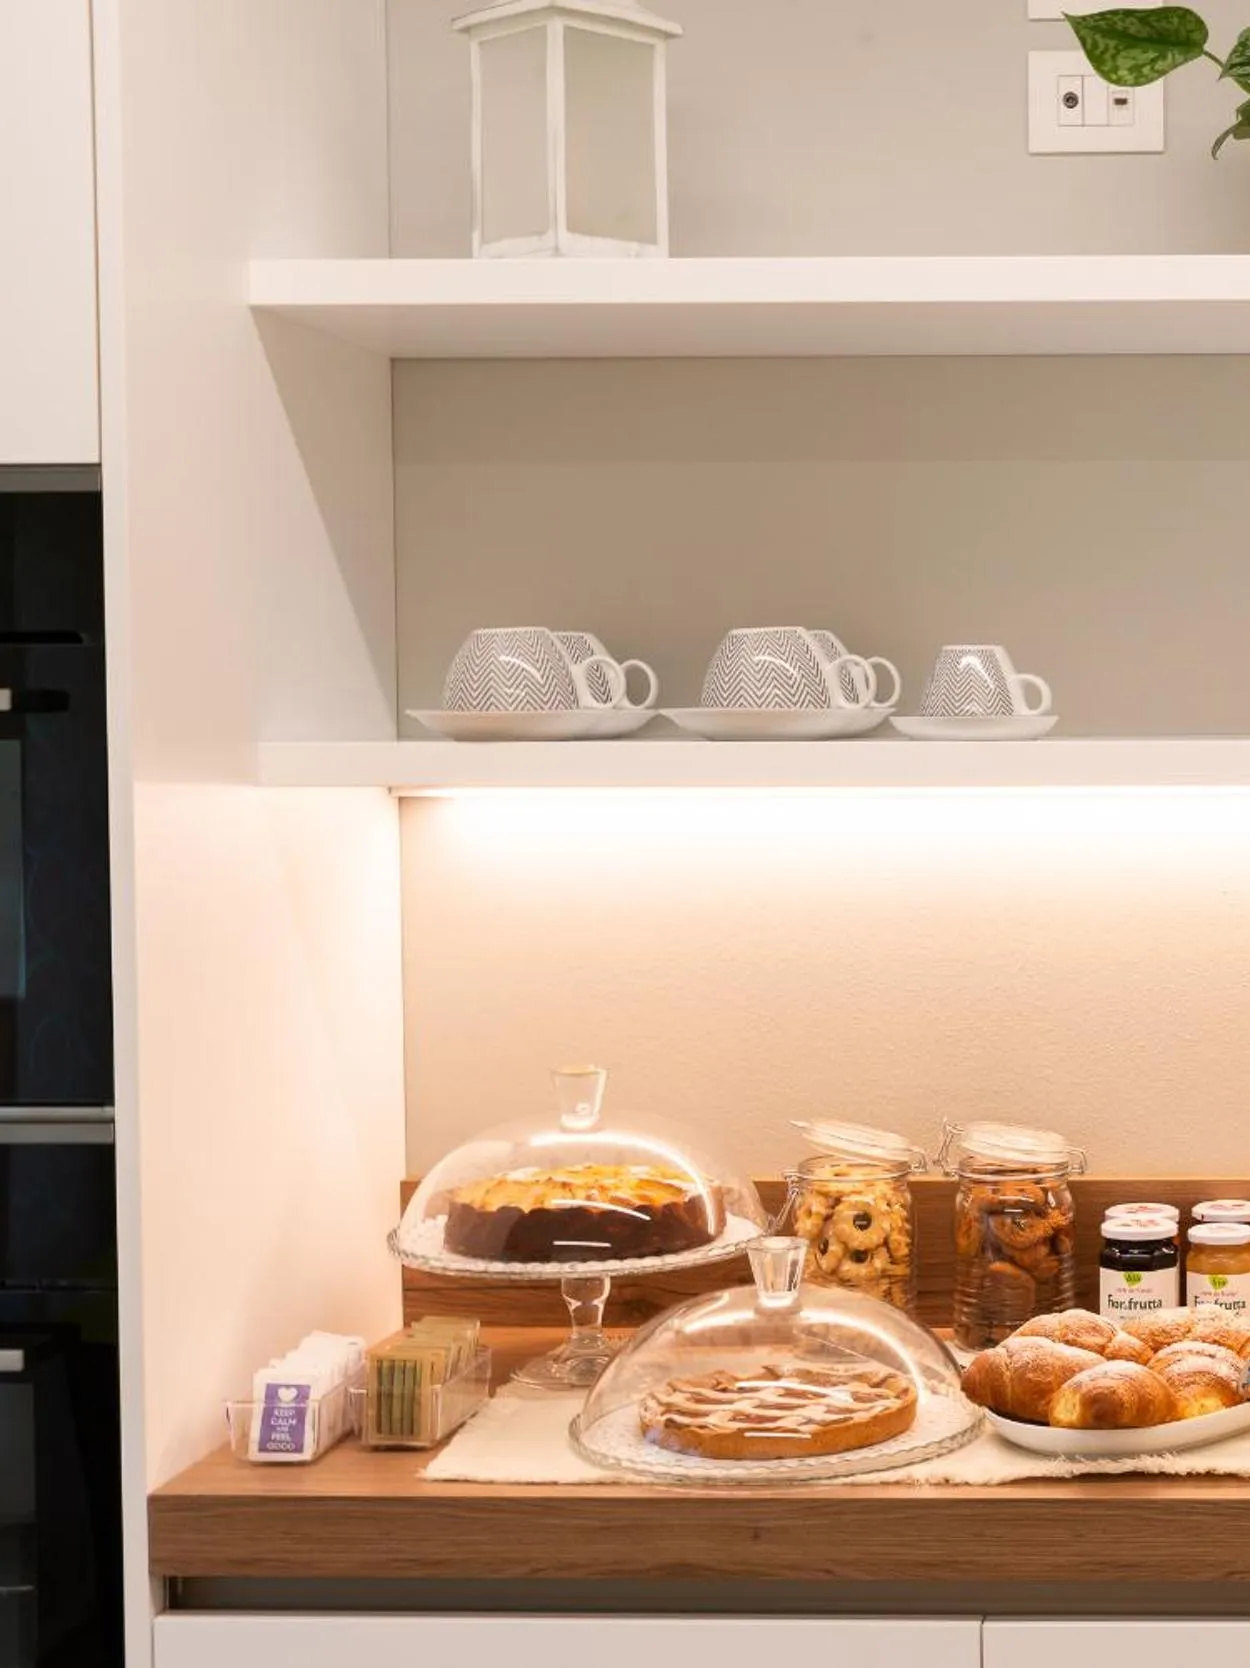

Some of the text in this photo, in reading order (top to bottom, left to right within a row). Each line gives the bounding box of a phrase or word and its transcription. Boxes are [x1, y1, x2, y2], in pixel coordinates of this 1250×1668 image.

[273, 1408, 295, 1417] KEEP
[271, 1417, 297, 1426] CALM
[271, 1432, 291, 1441] FEEL
[266, 1442, 296, 1451] GOOD
